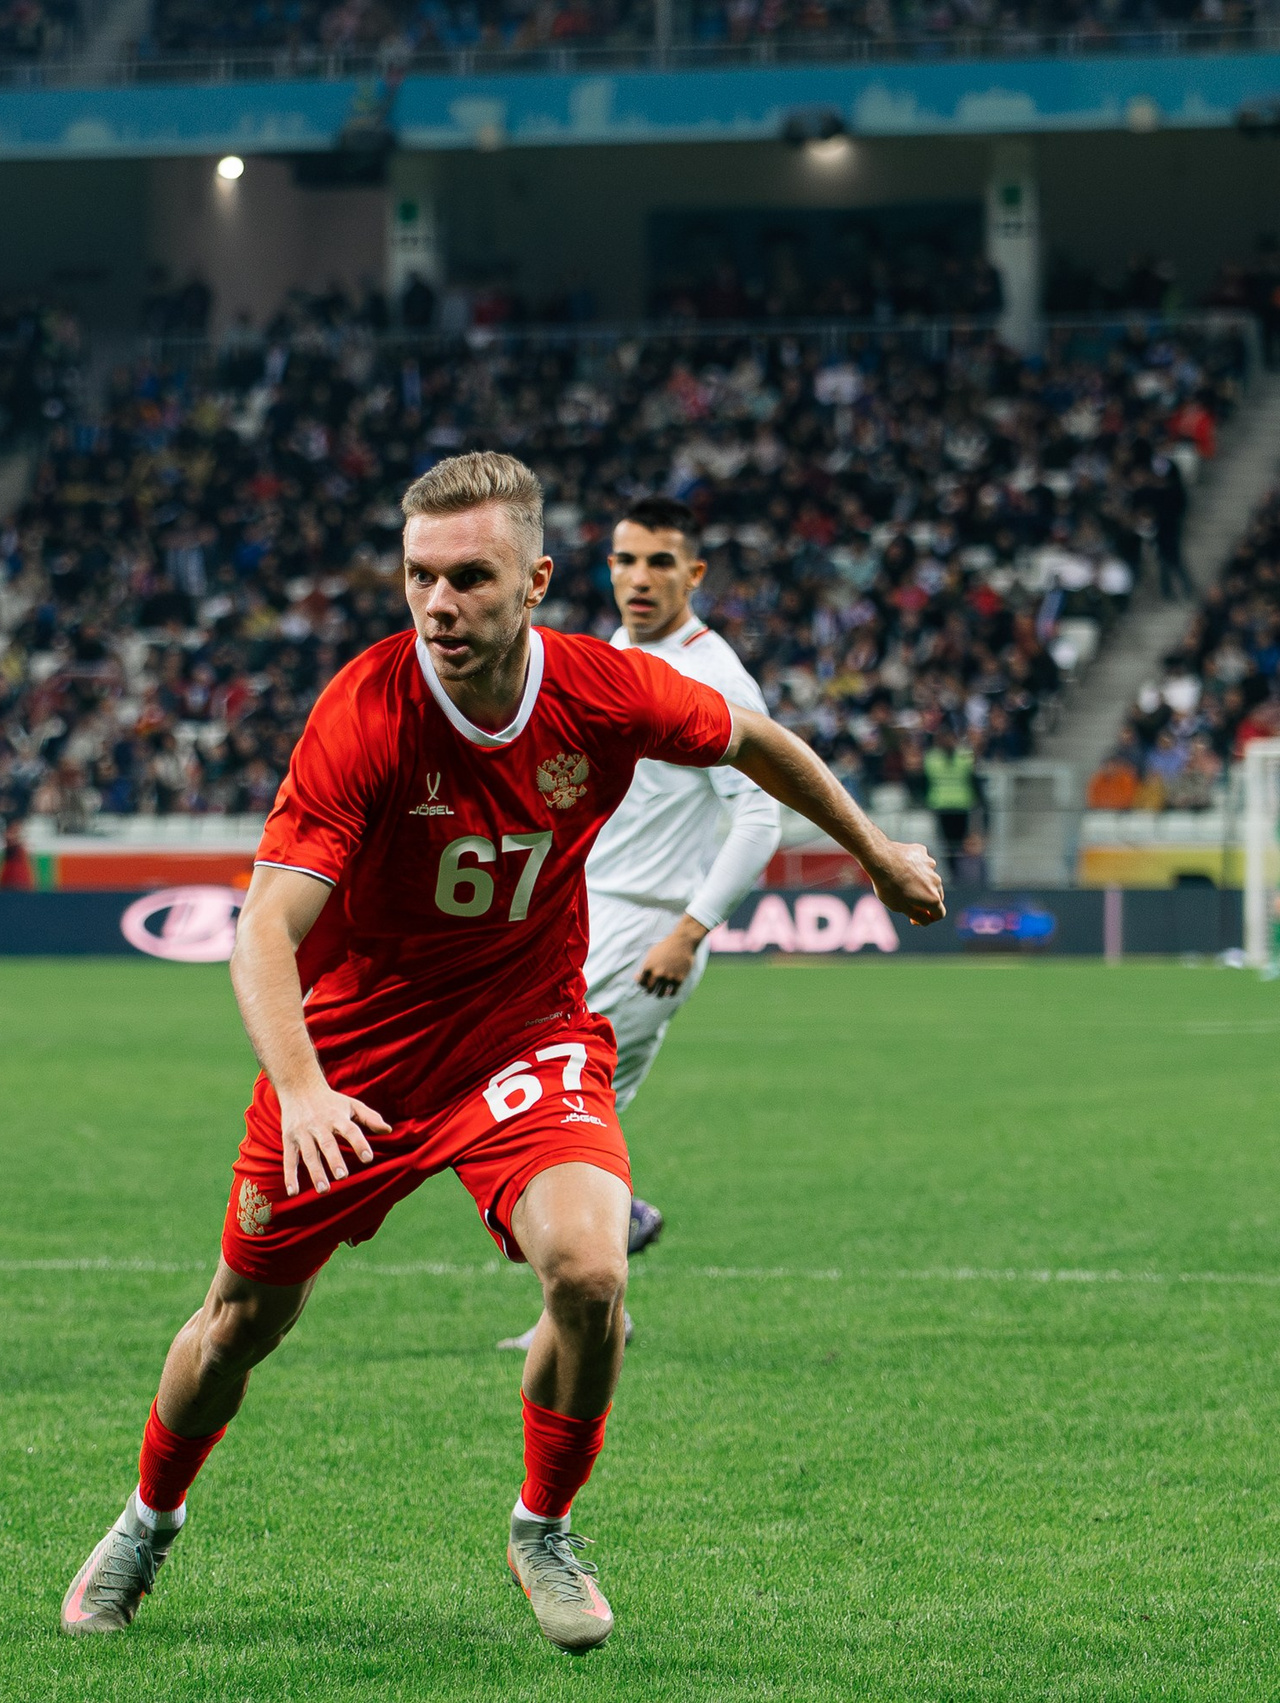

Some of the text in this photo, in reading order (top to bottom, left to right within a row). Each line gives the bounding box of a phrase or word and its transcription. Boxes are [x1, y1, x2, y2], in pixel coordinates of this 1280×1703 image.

[408, 803, 455, 816] JÖGEL
[434, 830, 553, 922] 67
[482, 1042, 588, 1123] 67
[560, 1112, 607, 1128] JÖGEL
